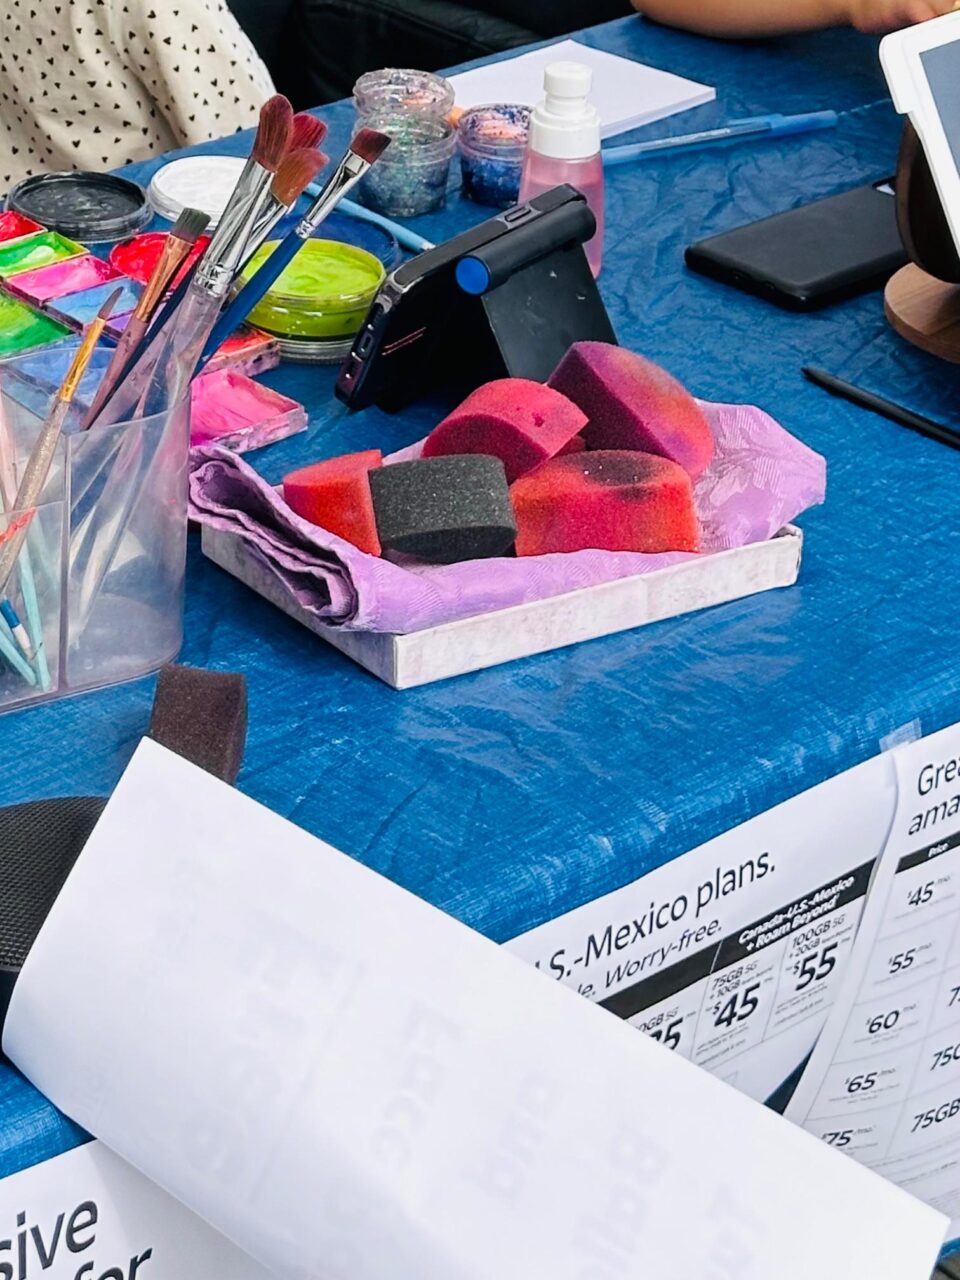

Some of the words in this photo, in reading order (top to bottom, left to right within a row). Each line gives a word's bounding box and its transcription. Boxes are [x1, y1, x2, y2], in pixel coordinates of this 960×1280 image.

[928, 842, 949, 858] Price
[695, 852, 775, 918] plans.
[756, 922, 791, 950] Roam
[792, 917, 831, 948] 100GB
[605, 919, 723, 988] Worry-free.
[712, 965, 743, 991] 75GB
[911, 1097, 960, 1134] 75GB
